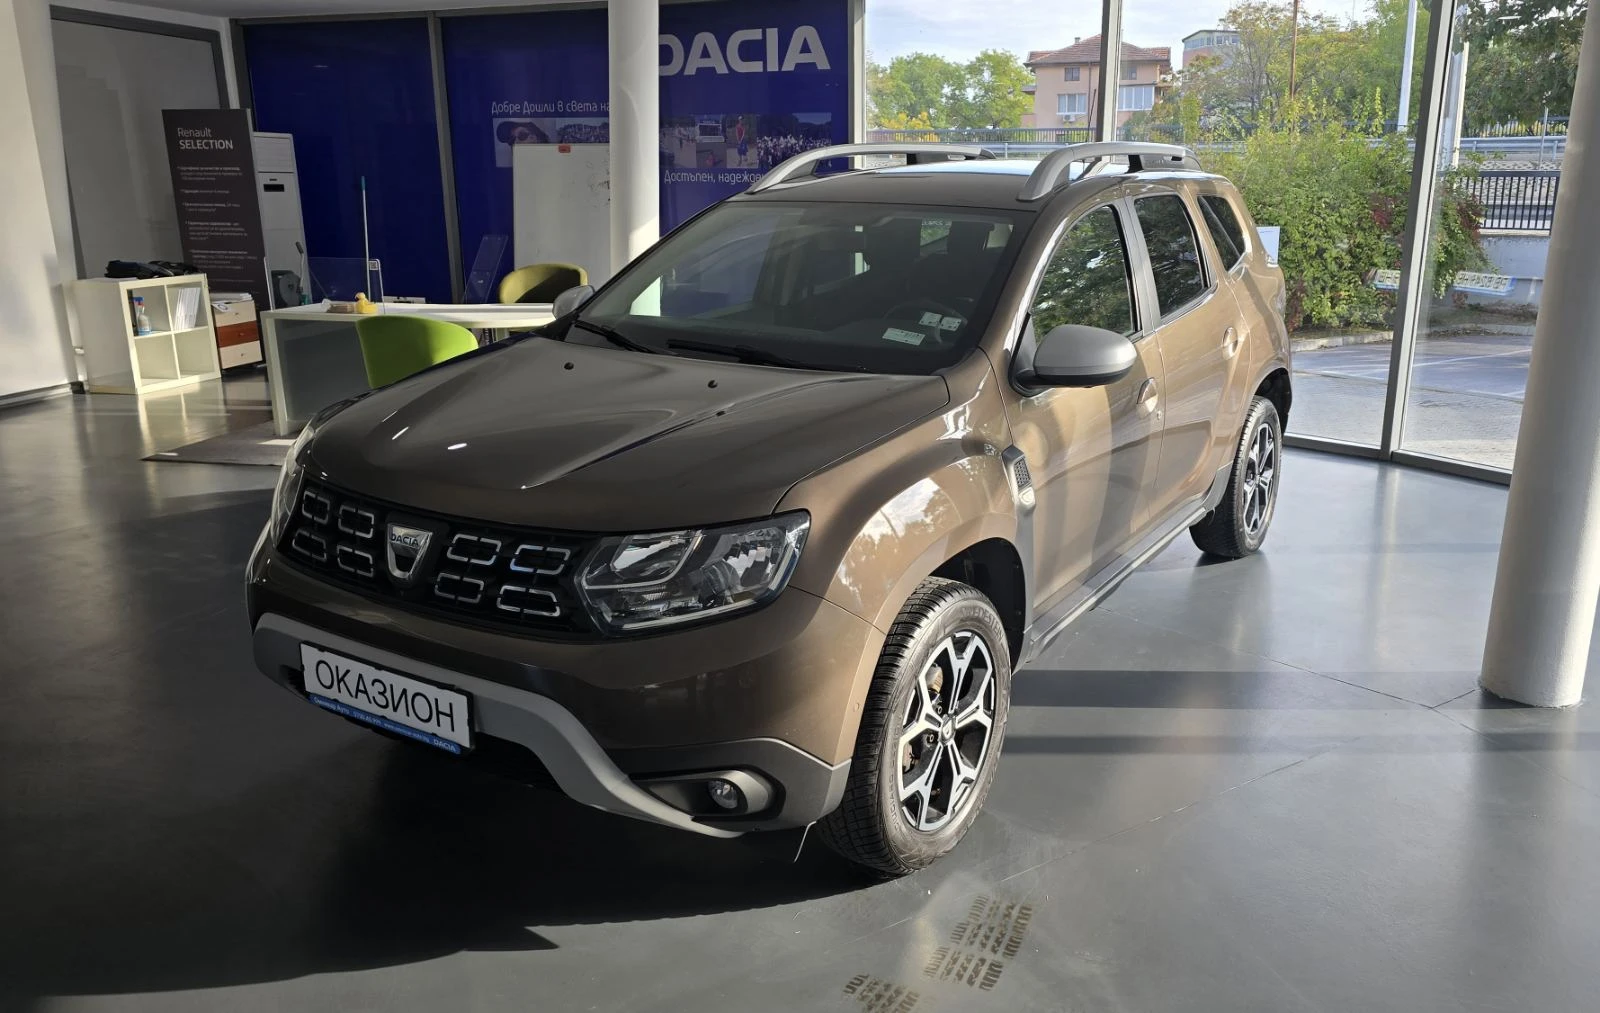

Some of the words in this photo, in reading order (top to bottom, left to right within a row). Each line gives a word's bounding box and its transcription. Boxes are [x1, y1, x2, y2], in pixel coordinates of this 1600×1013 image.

[659, 25, 831, 76] DACIA
[492, 101, 520, 116] Добре
[522, 100, 555, 115] Дошли
[566, 100, 598, 113] света
[177, 127, 212, 137] Renault
[179, 139, 234, 150] SELECTION
[664, 169, 716, 184] Достъпен,
[391, 533, 419, 547] DACIA
[316, 660, 455, 732] ОКАЗИОН
